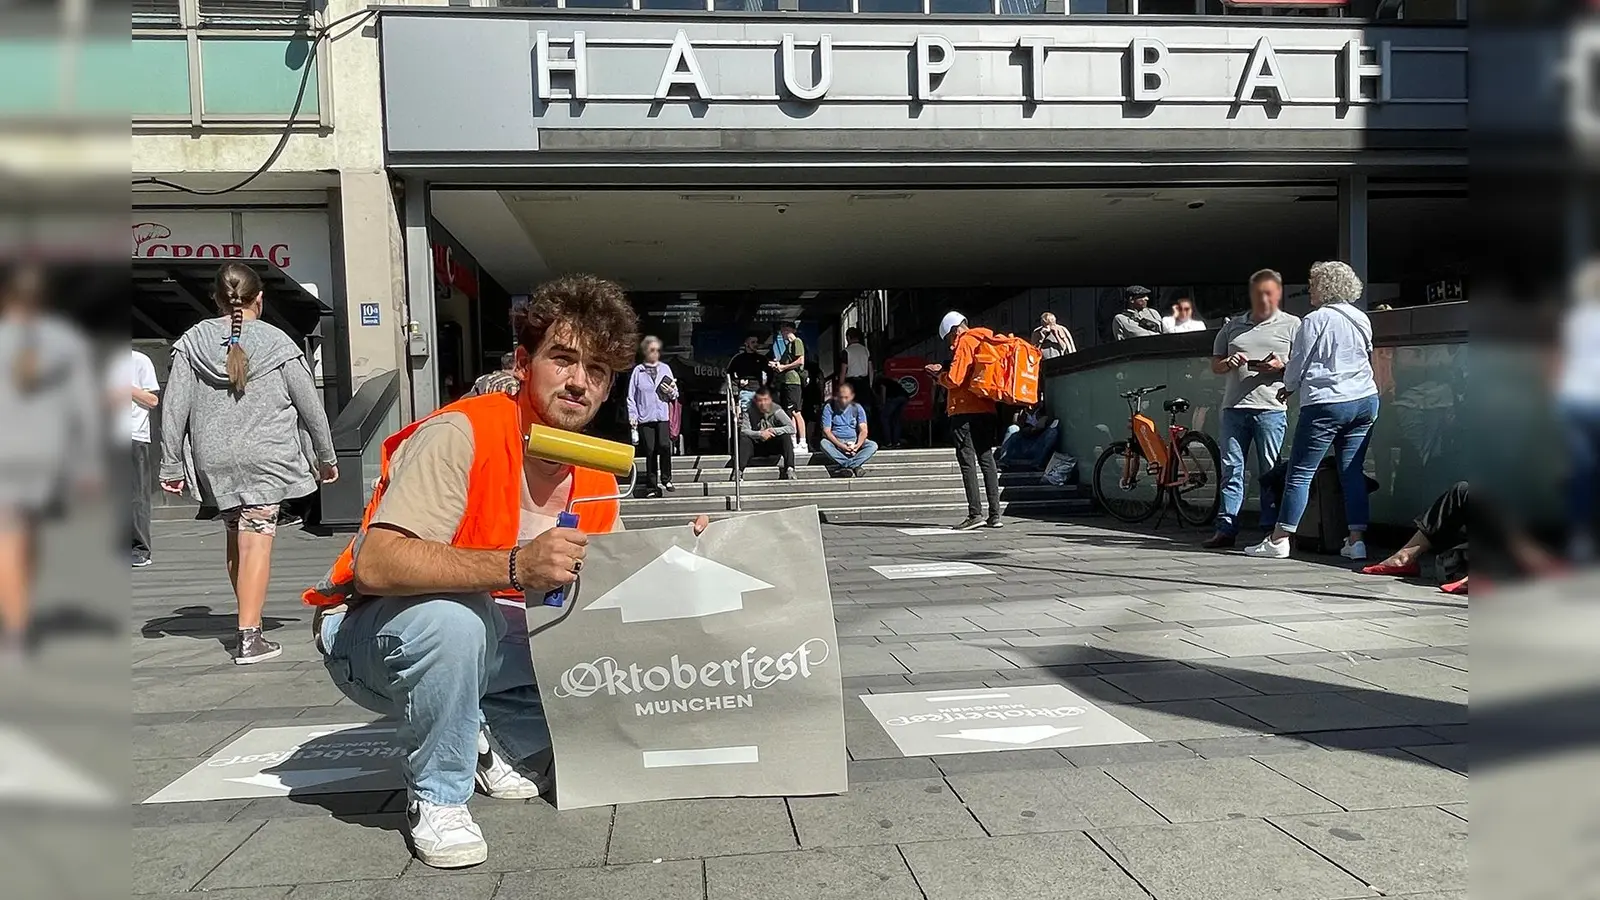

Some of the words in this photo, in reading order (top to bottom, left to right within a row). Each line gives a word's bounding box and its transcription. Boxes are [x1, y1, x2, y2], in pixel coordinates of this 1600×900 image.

[554, 638, 829, 698] Oktoberfest
[635, 694, 753, 716] MÜNCHEN
[886, 706, 1090, 726] Oktoberfest
